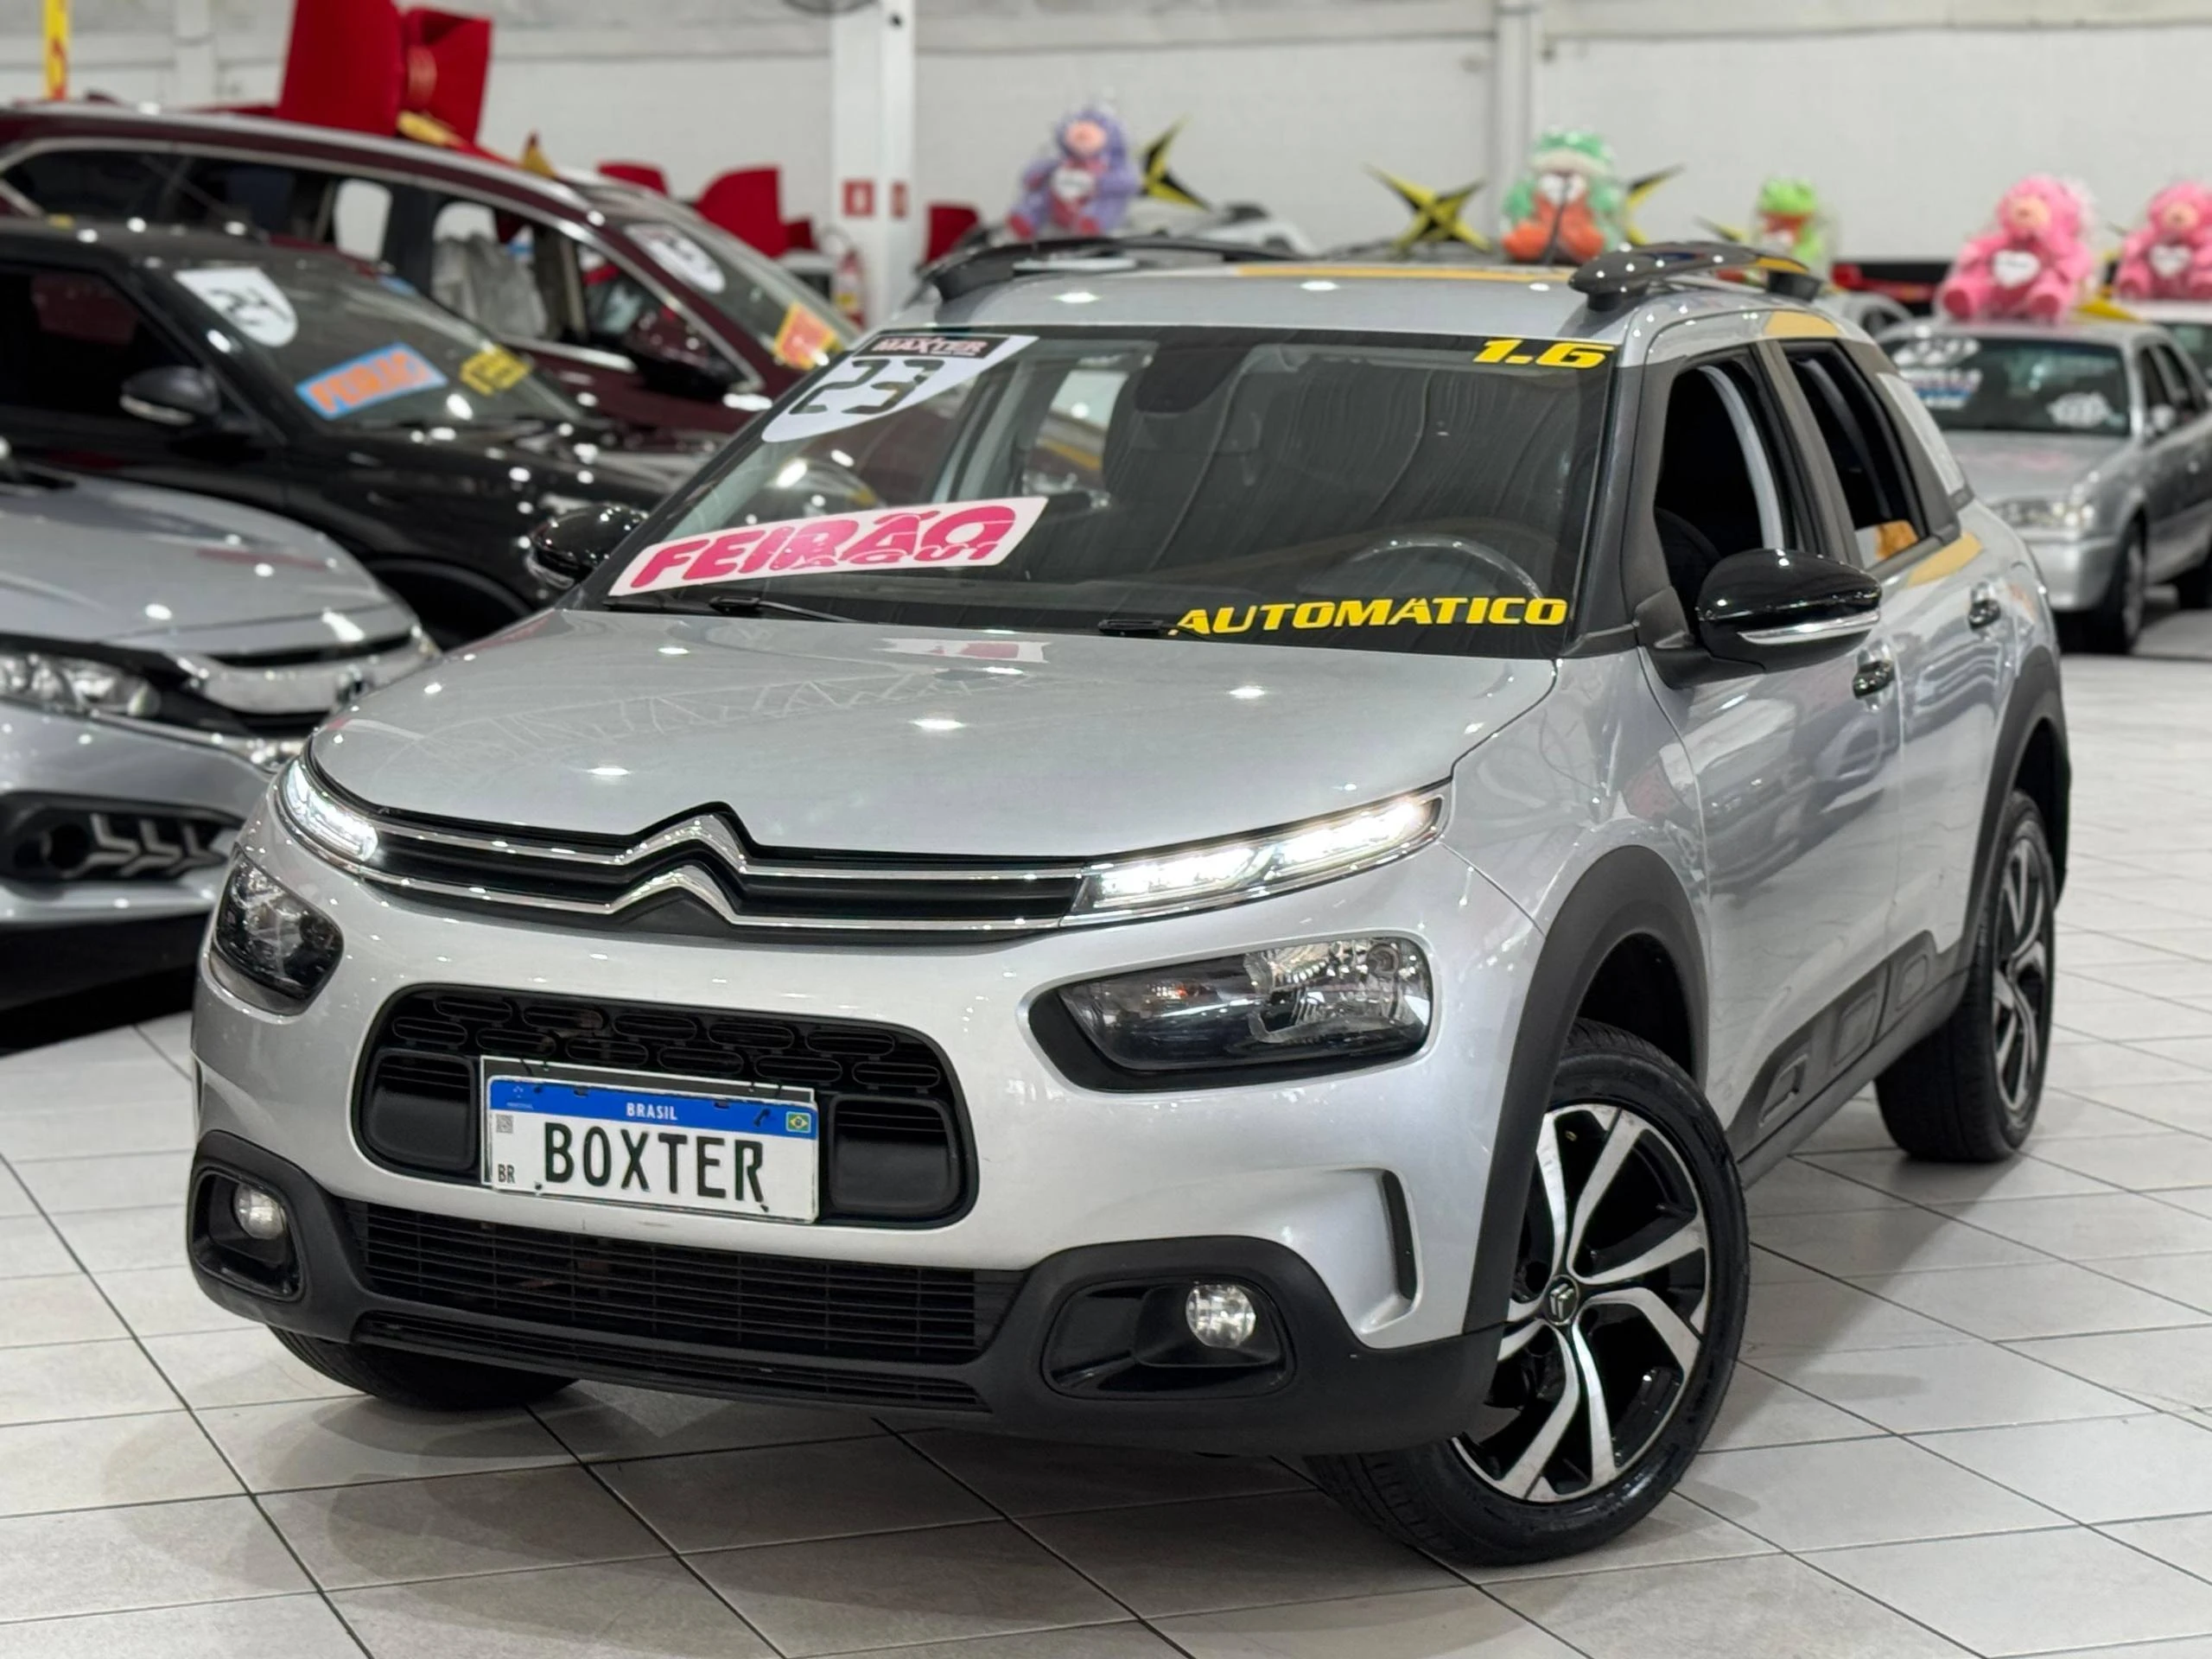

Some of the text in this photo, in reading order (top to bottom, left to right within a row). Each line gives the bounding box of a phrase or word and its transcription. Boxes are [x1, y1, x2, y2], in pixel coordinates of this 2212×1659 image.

[1472, 339, 1615, 368] 1.6
[788, 359, 944, 415] 23
[630, 505, 1016, 588] FEIRÃO
[626, 1102, 677, 1121] BRASIL
[497, 1164, 515, 1184] BR
[544, 1122, 765, 1204] BOXTER
